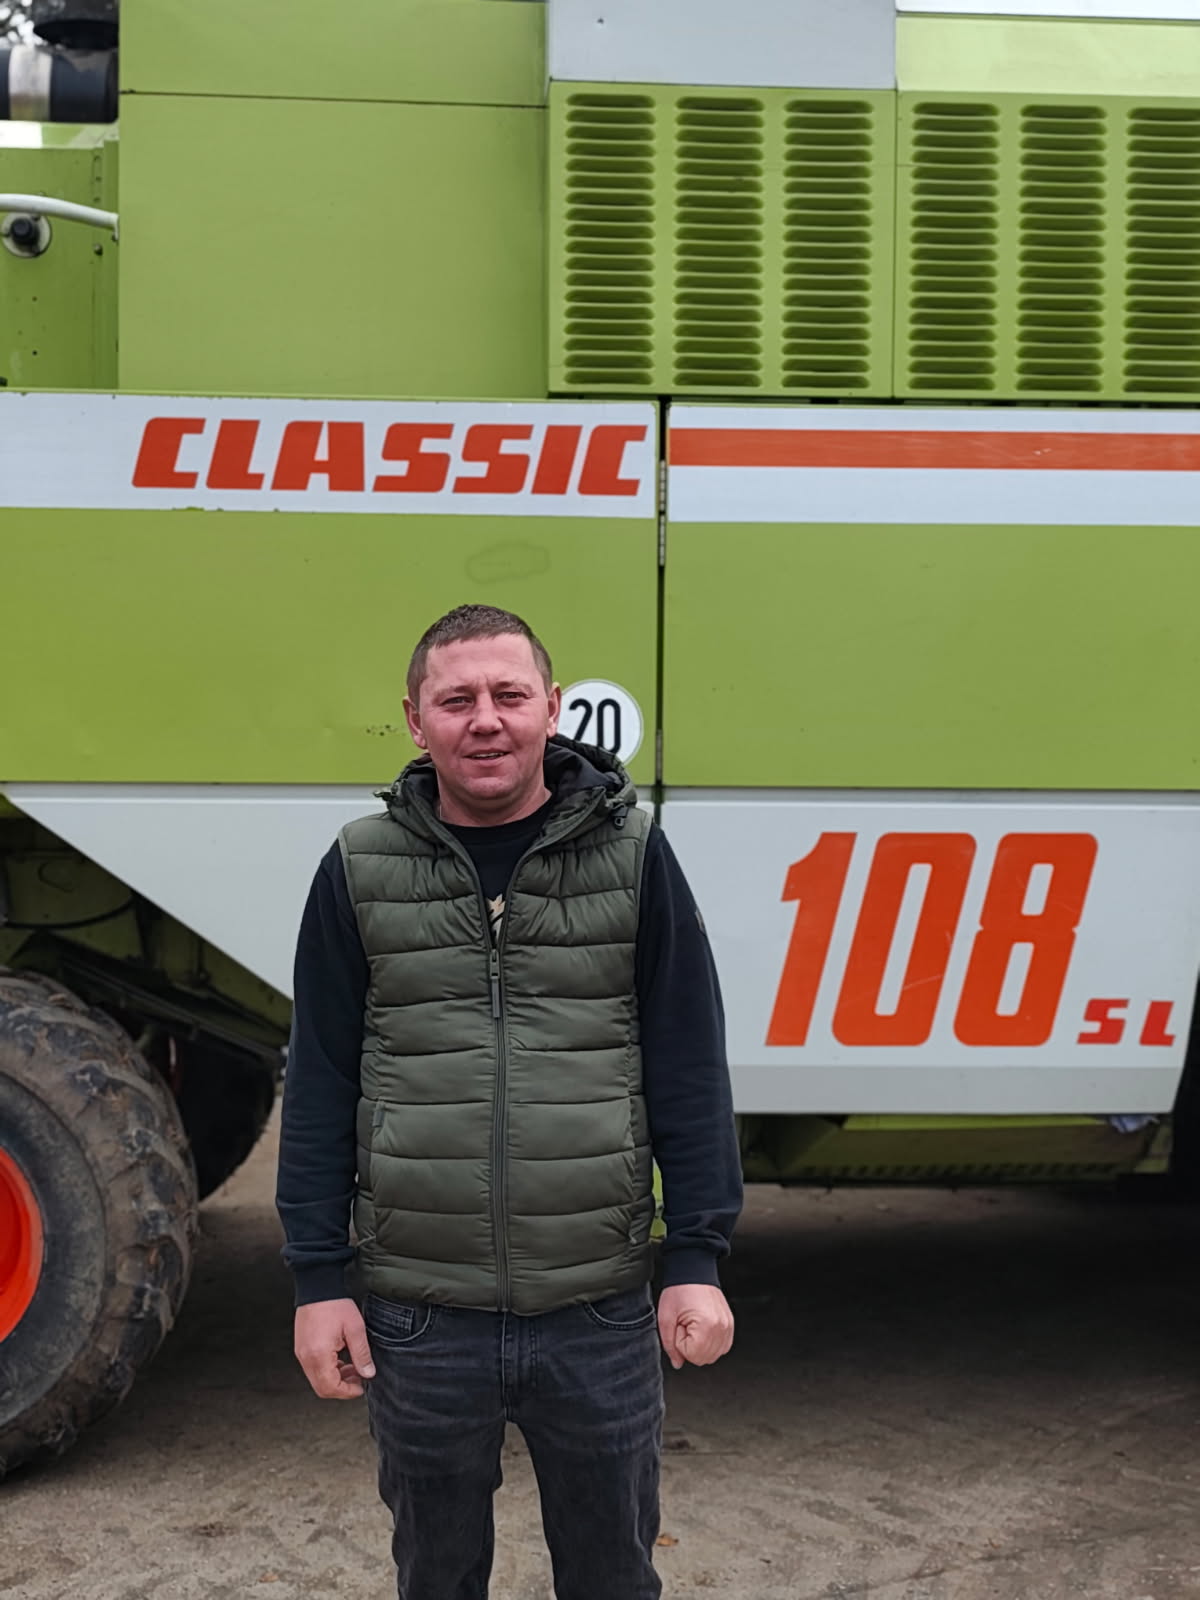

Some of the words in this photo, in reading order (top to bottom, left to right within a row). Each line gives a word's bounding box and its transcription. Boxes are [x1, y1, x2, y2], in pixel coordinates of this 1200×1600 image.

[132, 417, 647, 496] CLASSIC
[569, 698, 621, 754] 20
[766, 832, 1098, 1047] 108
[1077, 998, 1175, 1047] SL
